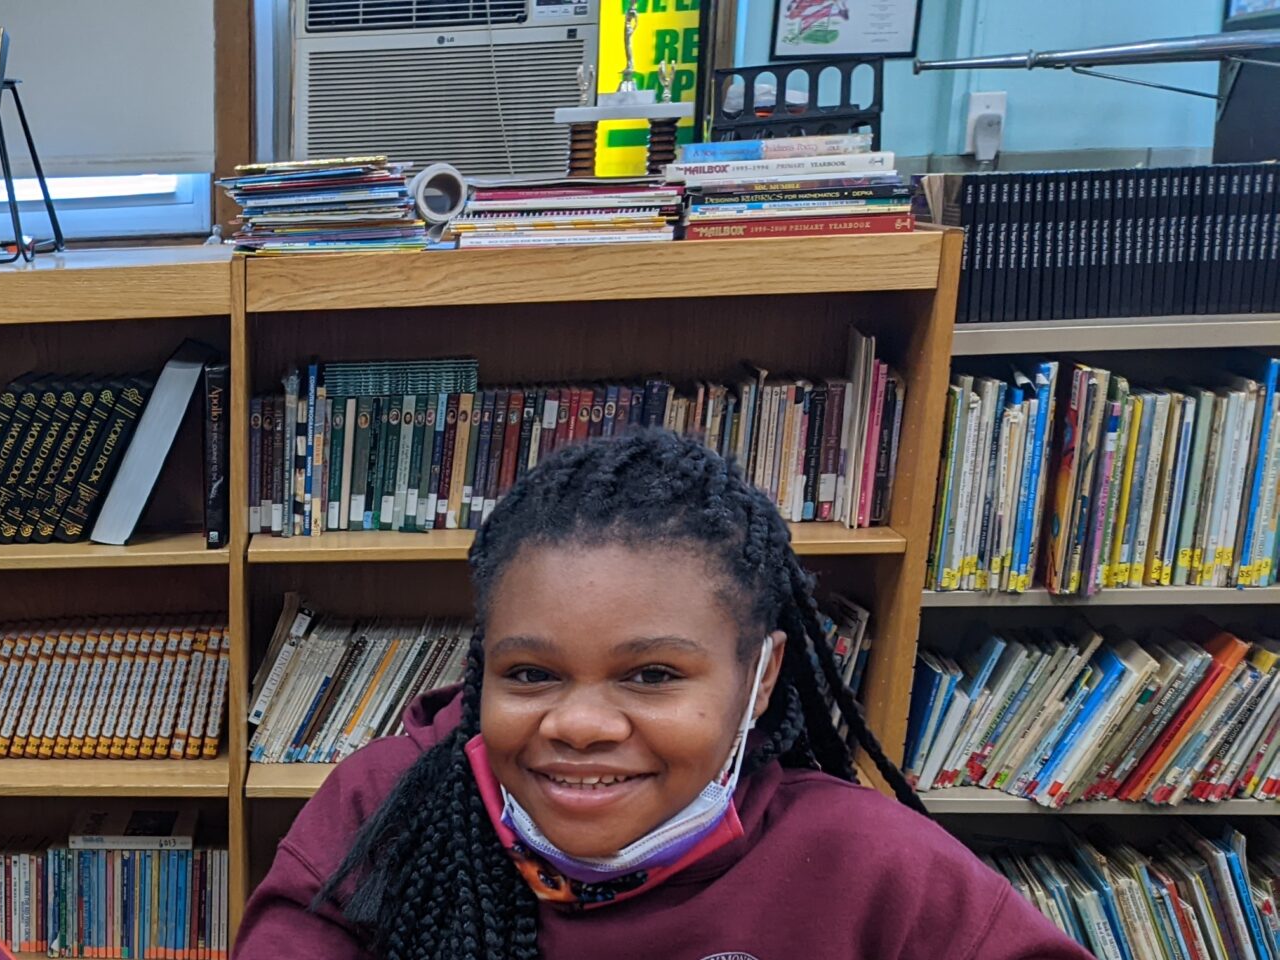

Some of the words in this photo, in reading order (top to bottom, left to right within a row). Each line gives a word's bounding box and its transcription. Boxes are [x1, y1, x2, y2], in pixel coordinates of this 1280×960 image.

[683, 164, 730, 175] MAILBOX
[810, 160, 846, 168] YEARBOOK
[798, 191, 840, 199] MATHEMATICS
[698, 226, 747, 237] MAILBOX
[789, 223, 825, 231] PRIMARY
[829, 222, 870, 230] YEARBOOK
[209, 385, 223, 421] Apollo
[0, 423, 22, 459] WORLD
[19, 422, 42, 460] WORLD
[39, 422, 60, 458] WORLD
[59, 422, 80, 458] WORLD
[77, 420, 99, 458] WORLD
[102, 419, 124, 456] WORLD
[6, 458, 23, 485] BOOK
[26, 456, 42, 484] BOOK
[44, 456, 60, 484] BOOK
[63, 456, 80, 483] BOOK
[89, 454, 106, 482] BOOK
[267, 648, 292, 686] GINGER
[257, 685, 274, 707] PYE
[1157, 686, 1176, 706] CARROT
[1170, 678, 1182, 689] THE
[1150, 702, 1164, 716] SEED
[1236, 708, 1250, 724] me
[1224, 722, 1242, 743] some
